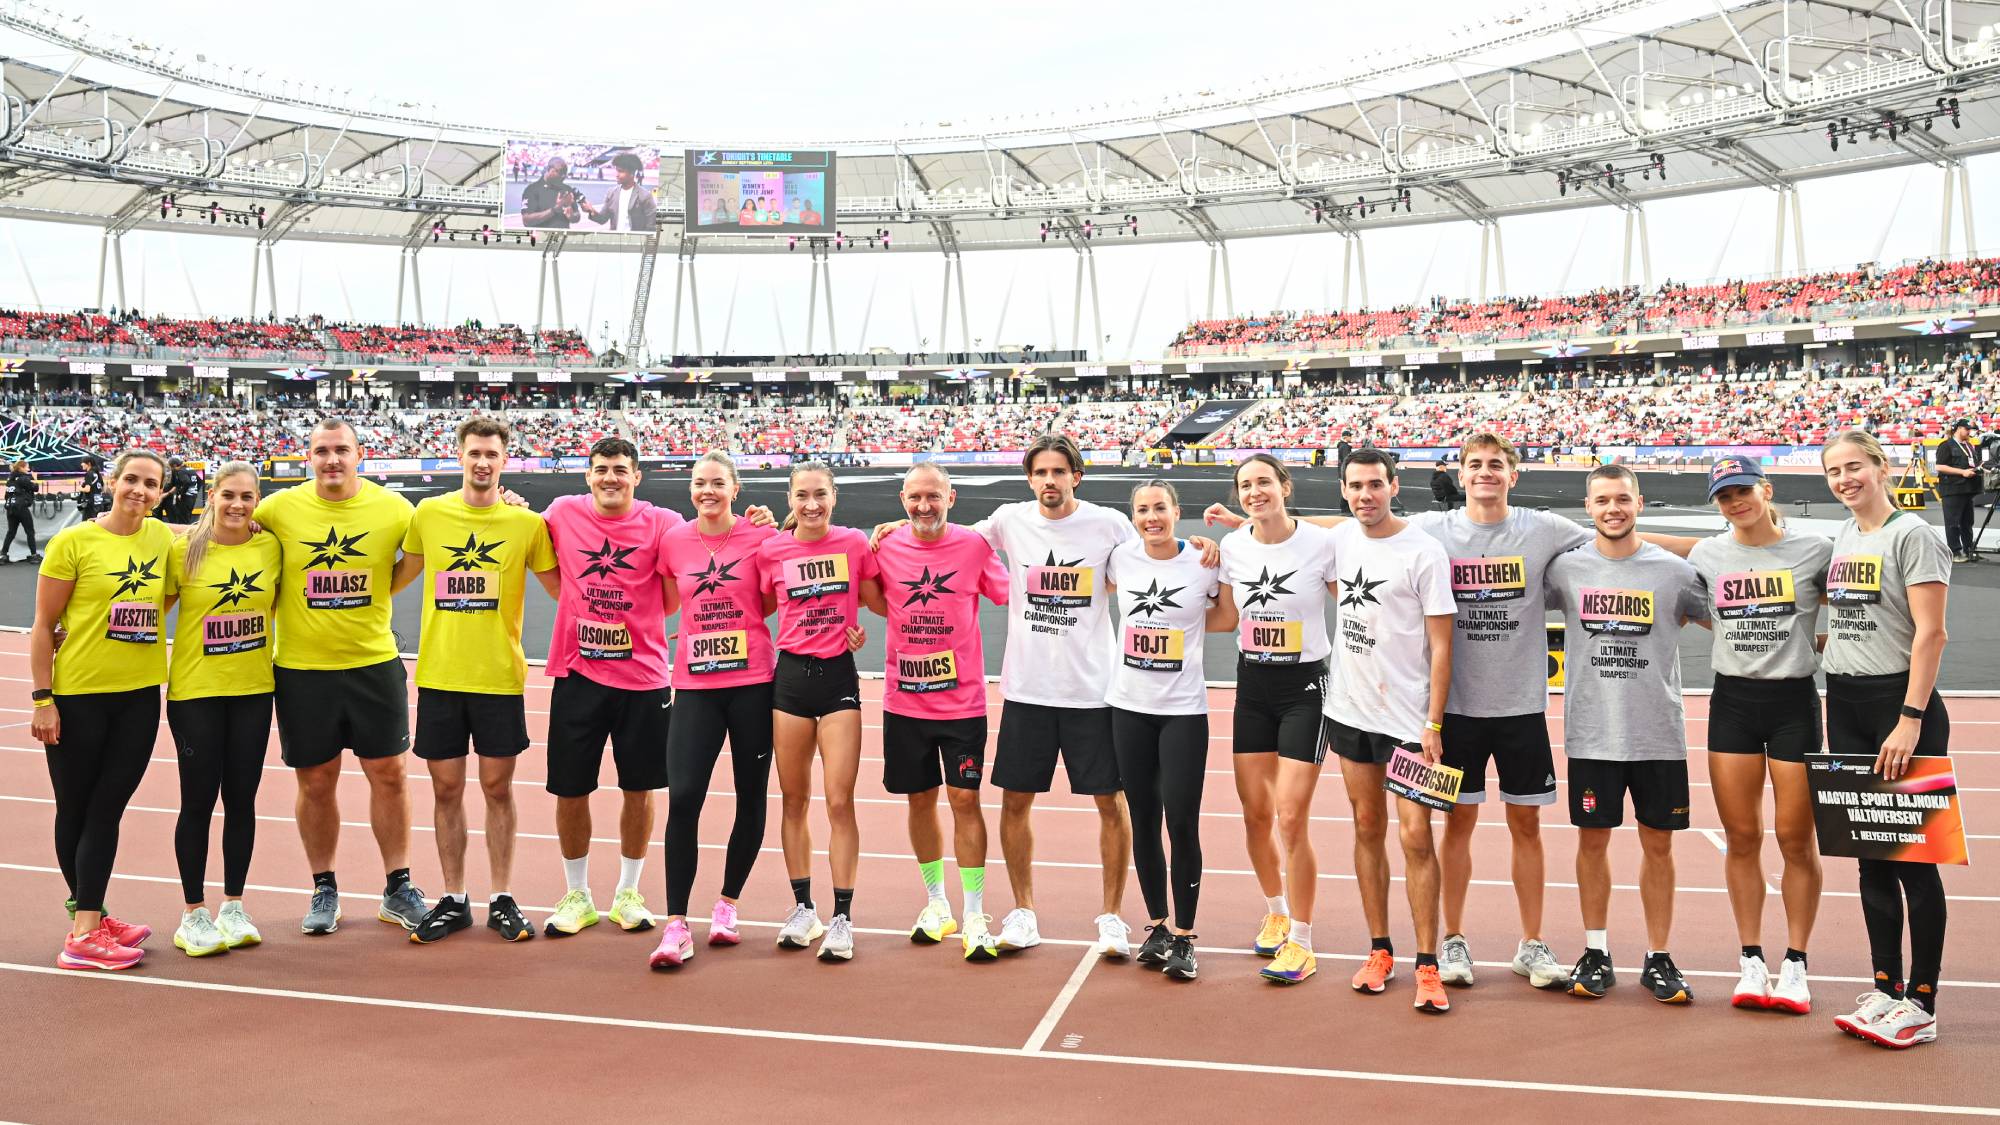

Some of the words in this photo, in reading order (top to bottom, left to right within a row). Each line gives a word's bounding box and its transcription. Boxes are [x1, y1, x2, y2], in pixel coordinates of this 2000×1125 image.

[722, 152, 756, 160] TONIGHT'S
[757, 152, 792, 162] TIMETABLE
[1746, 331, 1786, 346] WELCOME
[1813, 326, 1854, 342] WELCOME
[1682, 336, 1720, 350] WELCOME
[1904, 494, 1916, 506] 41
[797, 558, 835, 581] TÓTH
[1454, 562, 1521, 584] BETLEHEM
[313, 573, 367, 593] HALÁSZ
[448, 577, 486, 594] RABB
[1041, 572, 1079, 591] NAGY
[587, 588, 624, 600] ULTIMATE
[1724, 577, 1783, 601] SZALAI
[701, 602, 733, 612] ULTIMATE
[1583, 591, 1650, 617] MÉSZÁROS
[694, 610, 743, 622] CHAMPIONSHIP
[806, 608, 837, 617] ULTIMATE
[1024, 611, 1077, 626] CHAMPIONSHIP
[1469, 610, 1508, 620] ULTIMATE
[702, 622, 728, 631] BUDAPEST
[910, 616, 944, 625] ULTIMATE
[1458, 620, 1519, 630] CHAMPIONSHIP
[1737, 620, 1776, 630] ULTIMATE
[207, 616, 264, 639] KLUJBER
[902, 624, 954, 635] CHAMPIONSHIP
[1032, 625, 1059, 635] BUDAPEST
[1253, 627, 1285, 647] GUZI
[1468, 633, 1500, 641] BUDAPEST
[1725, 631, 1790, 641] CHAMPIONSHIP
[693, 636, 739, 658] SPIESZ
[1134, 634, 1169, 654] FOJT
[1735, 644, 1769, 652] BUDAPEST
[1600, 646, 1637, 657] ULTIMATE
[900, 656, 951, 678] KOVÁCS
[1591, 657, 1649, 669] CHAMPIONSHIP
[1600, 670, 1629, 679] BUDAPEST
[1818, 791, 1859, 806] MAGYAR
[1860, 792, 1894, 807] SPORT
[1896, 794, 1950, 809] BAJNOKAI
[1852, 830, 1858, 840] 1.
[1860, 831, 1897, 842] HELYEZETT
[1899, 832, 1926, 844] CSAPAT
